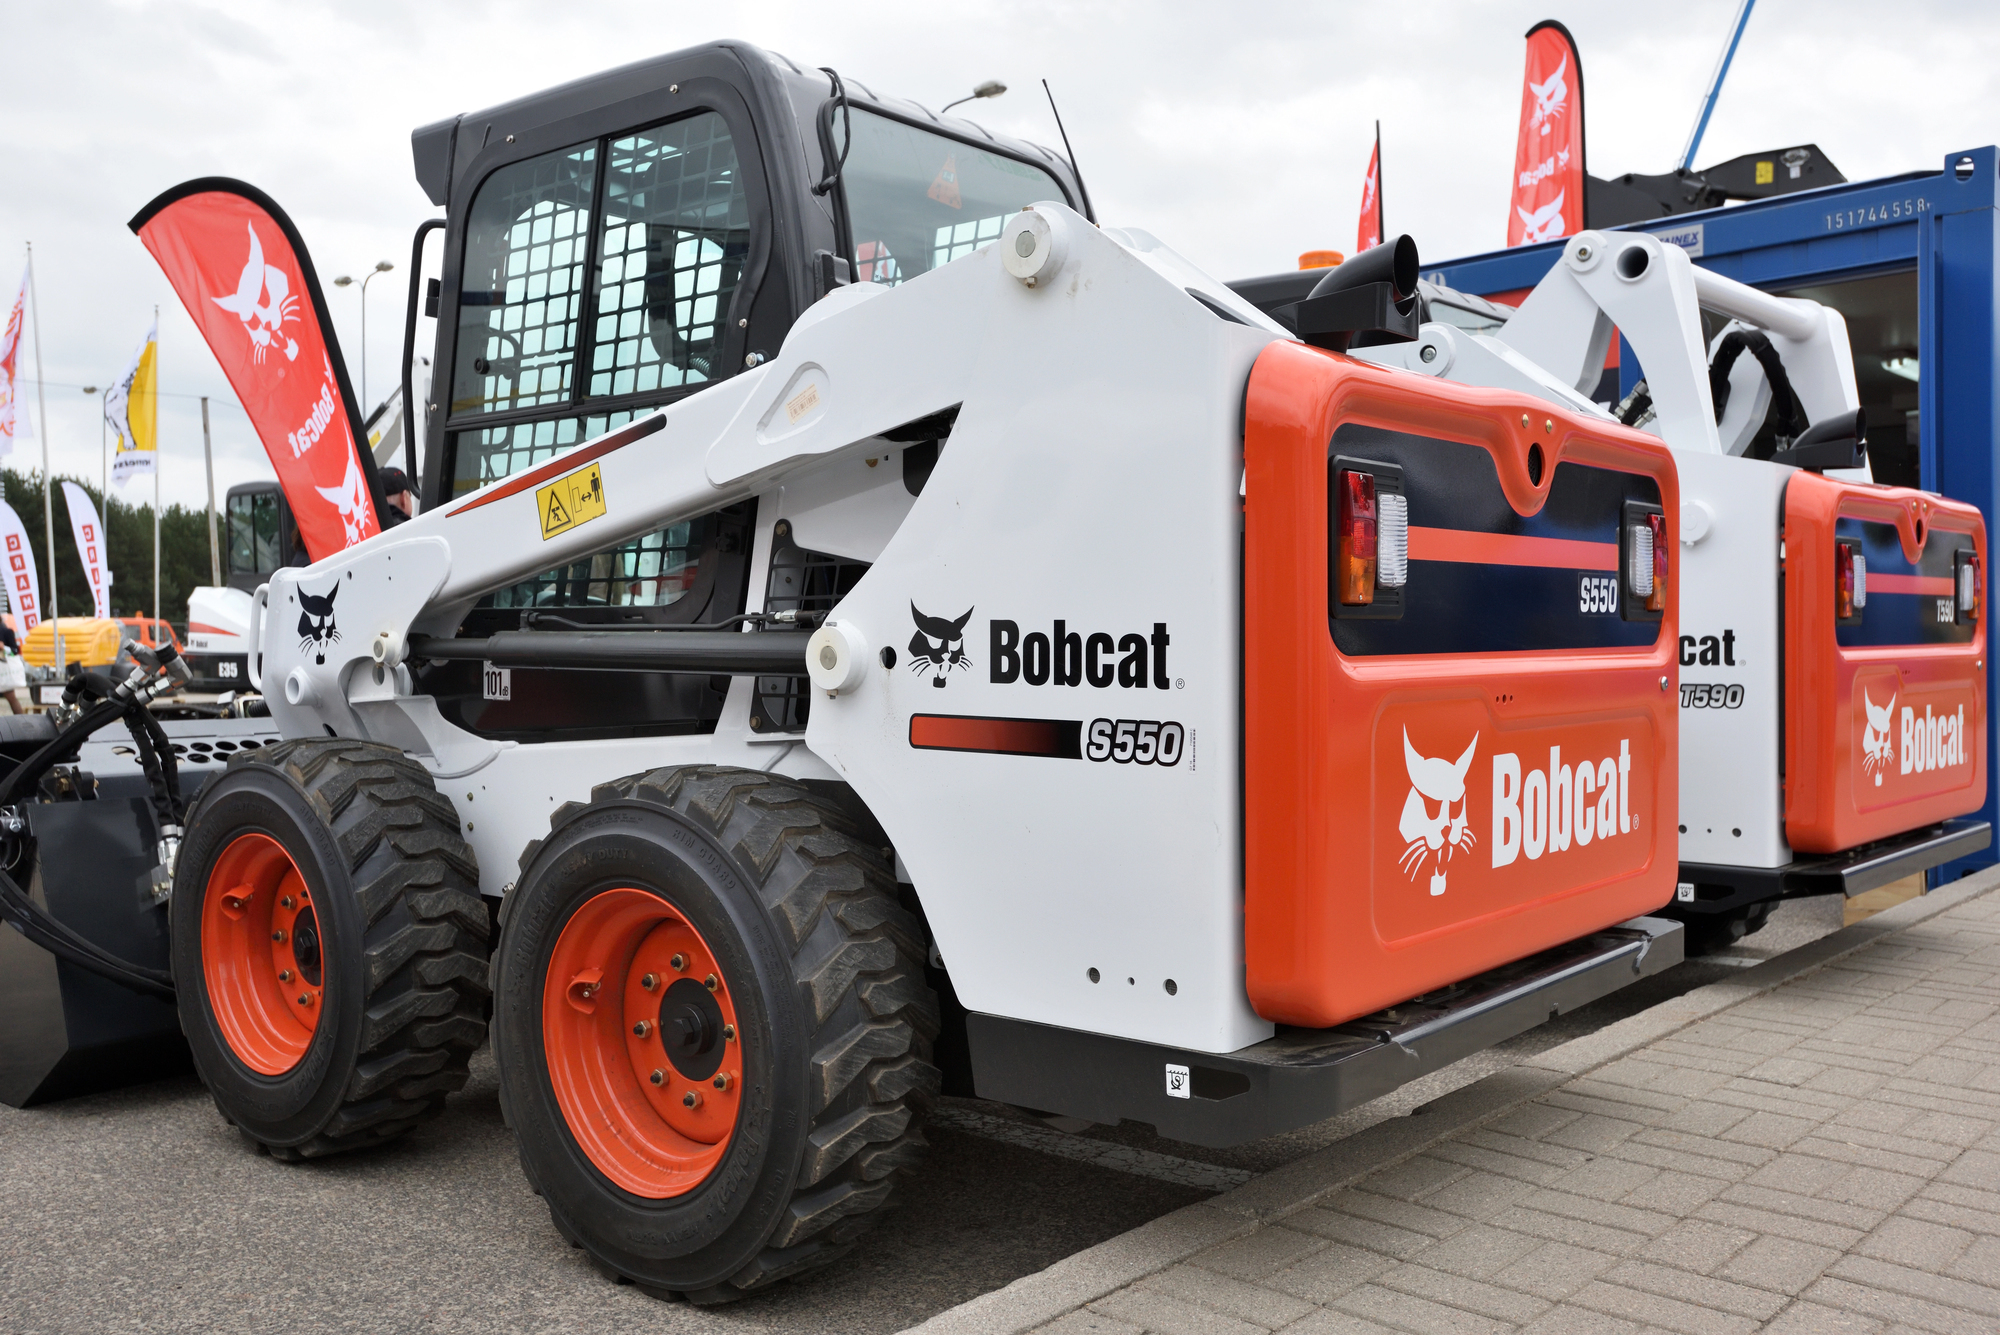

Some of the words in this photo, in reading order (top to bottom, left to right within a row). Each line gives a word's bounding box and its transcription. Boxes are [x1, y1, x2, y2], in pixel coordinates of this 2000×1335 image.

[1580, 577, 1618, 613] S550
[1937, 600, 1954, 623] T590
[990, 619, 1170, 690] Bobcat
[1678, 629, 1736, 666] cat
[218, 662, 238, 678] E35
[485, 671, 502, 696] 101
[1680, 683, 1745, 709] T590
[1086, 717, 1185, 767] S550
[1901, 703, 1964, 775] Bobcat
[1492, 738, 1631, 869] Bobcat
[600, 847, 631, 860] DUTY
[672, 829, 696, 848] RIM
[699, 848, 738, 890] GUARD
